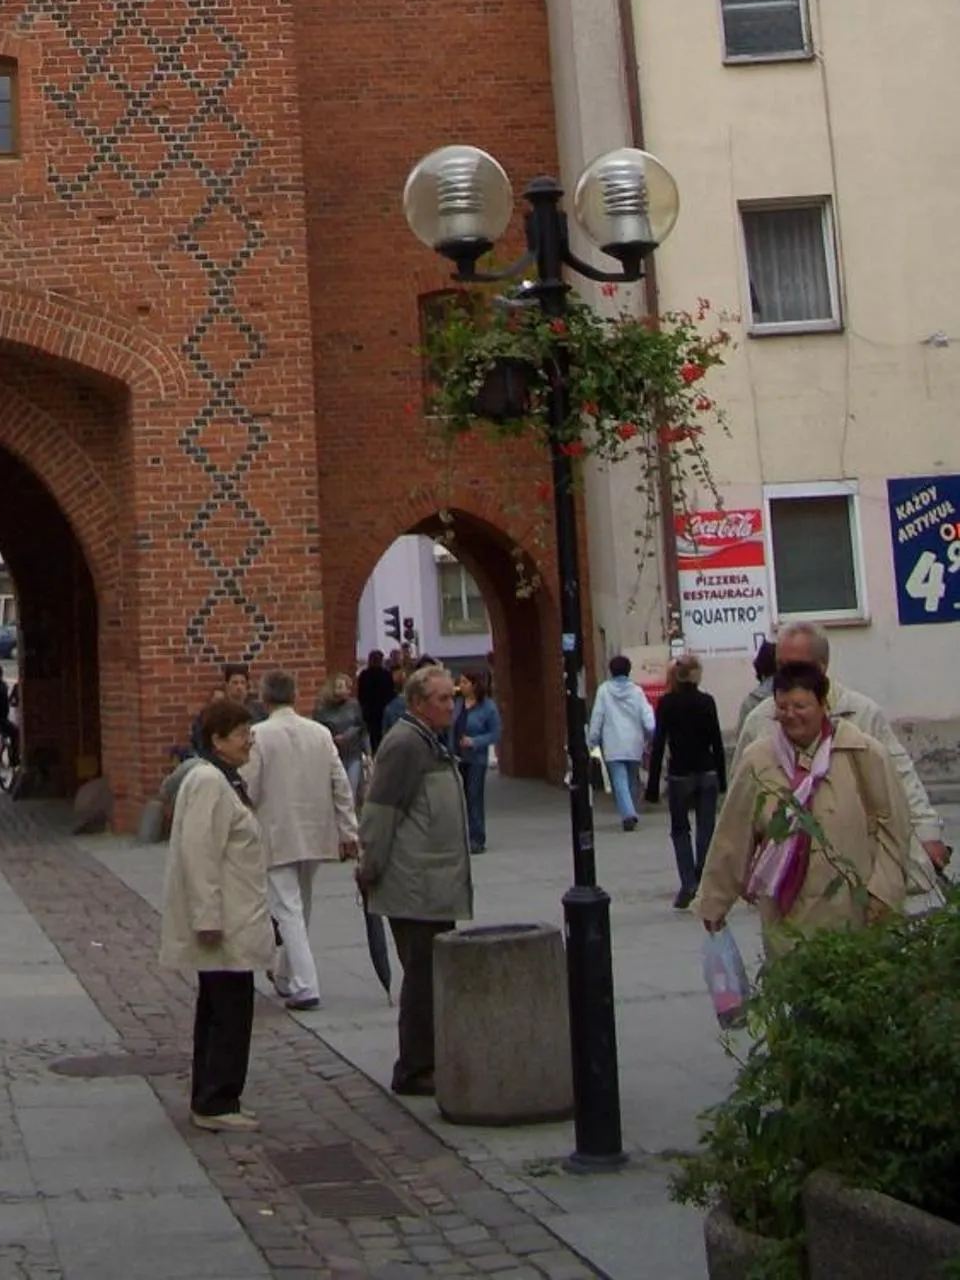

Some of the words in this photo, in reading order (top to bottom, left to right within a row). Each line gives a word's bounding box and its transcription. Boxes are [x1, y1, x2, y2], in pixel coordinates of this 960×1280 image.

[898, 501, 956, 543] ARTYKUŁ
[695, 574, 749, 586] PIZZERIA
[683, 587, 764, 601] RESTAURACJA
